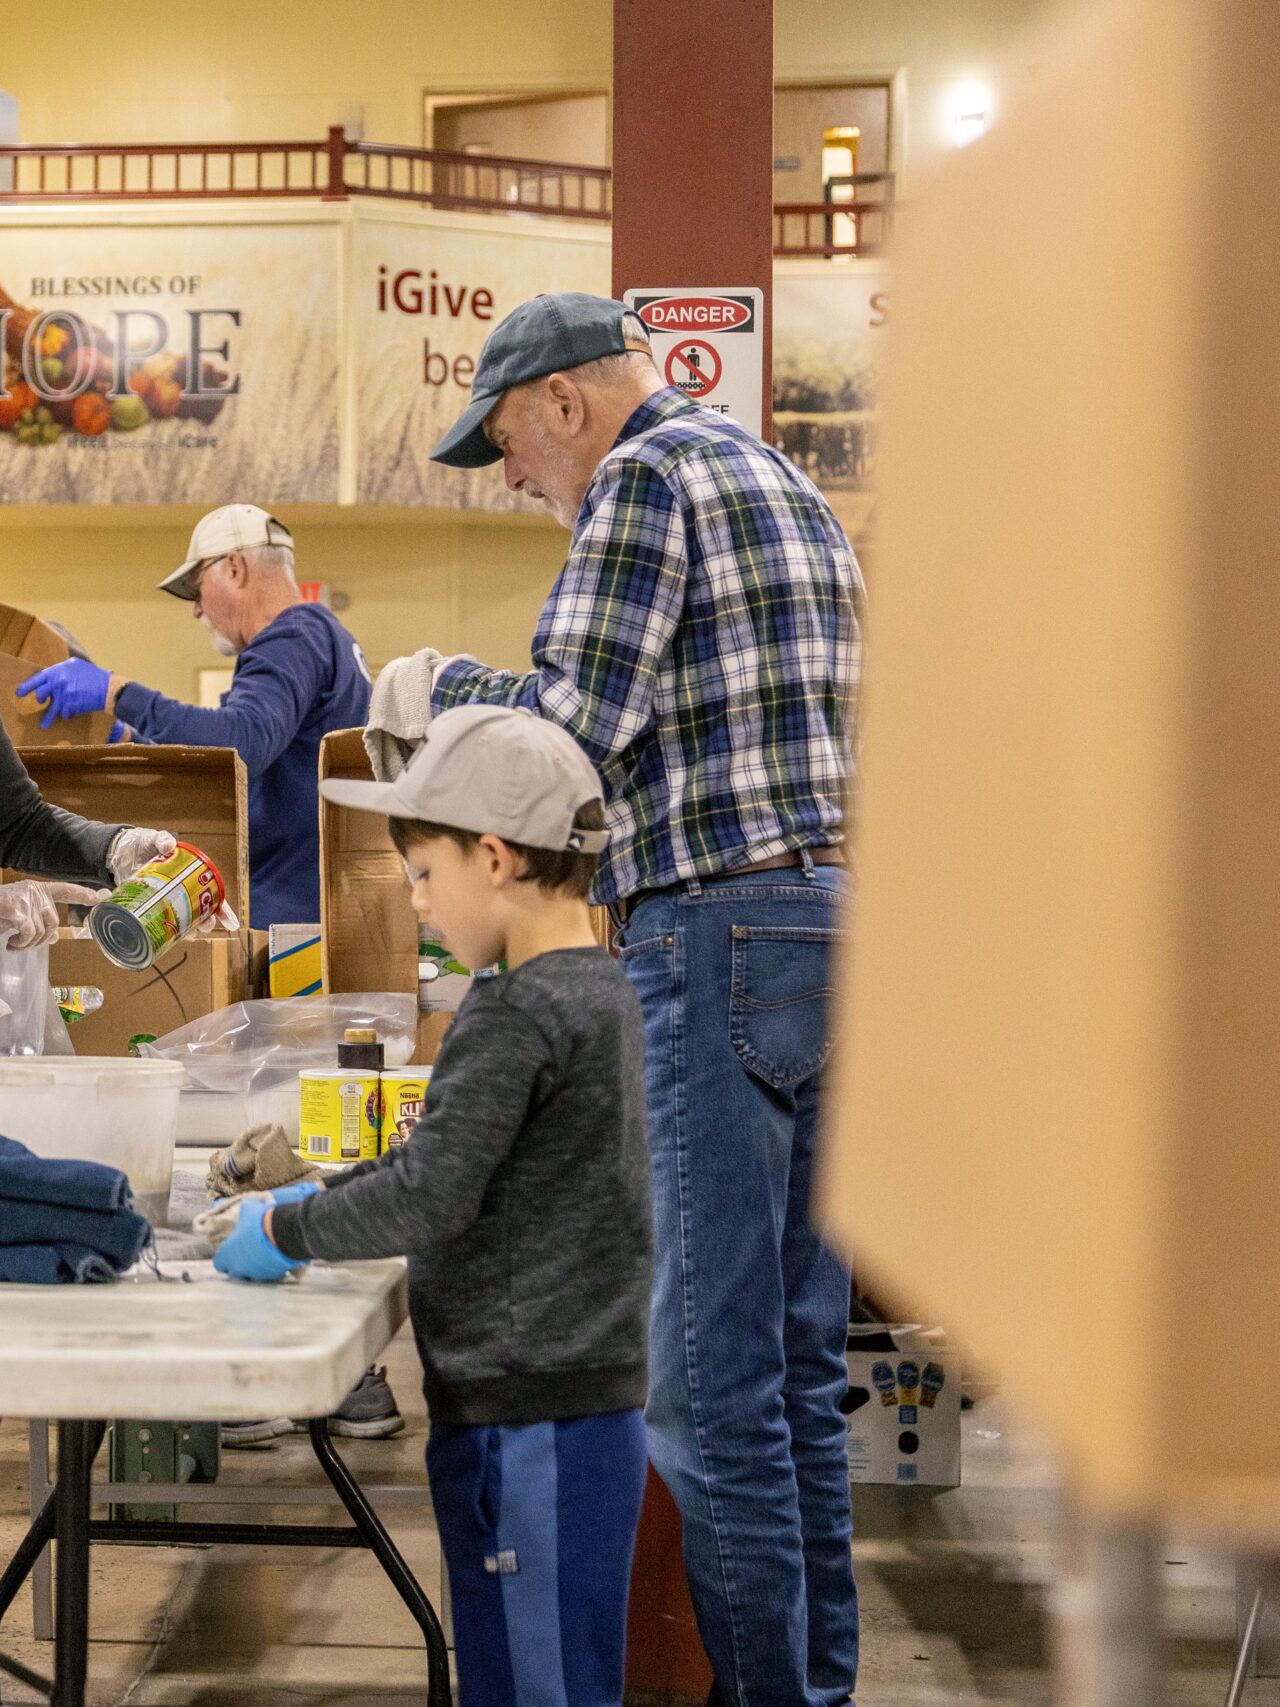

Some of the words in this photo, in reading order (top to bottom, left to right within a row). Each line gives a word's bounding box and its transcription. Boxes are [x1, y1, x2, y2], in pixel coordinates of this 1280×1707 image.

[31, 276, 162, 296] BLESSINGS
[169, 275, 202, 294] OF
[378, 265, 493, 320] iGive
[651, 306, 736, 323] DANGER
